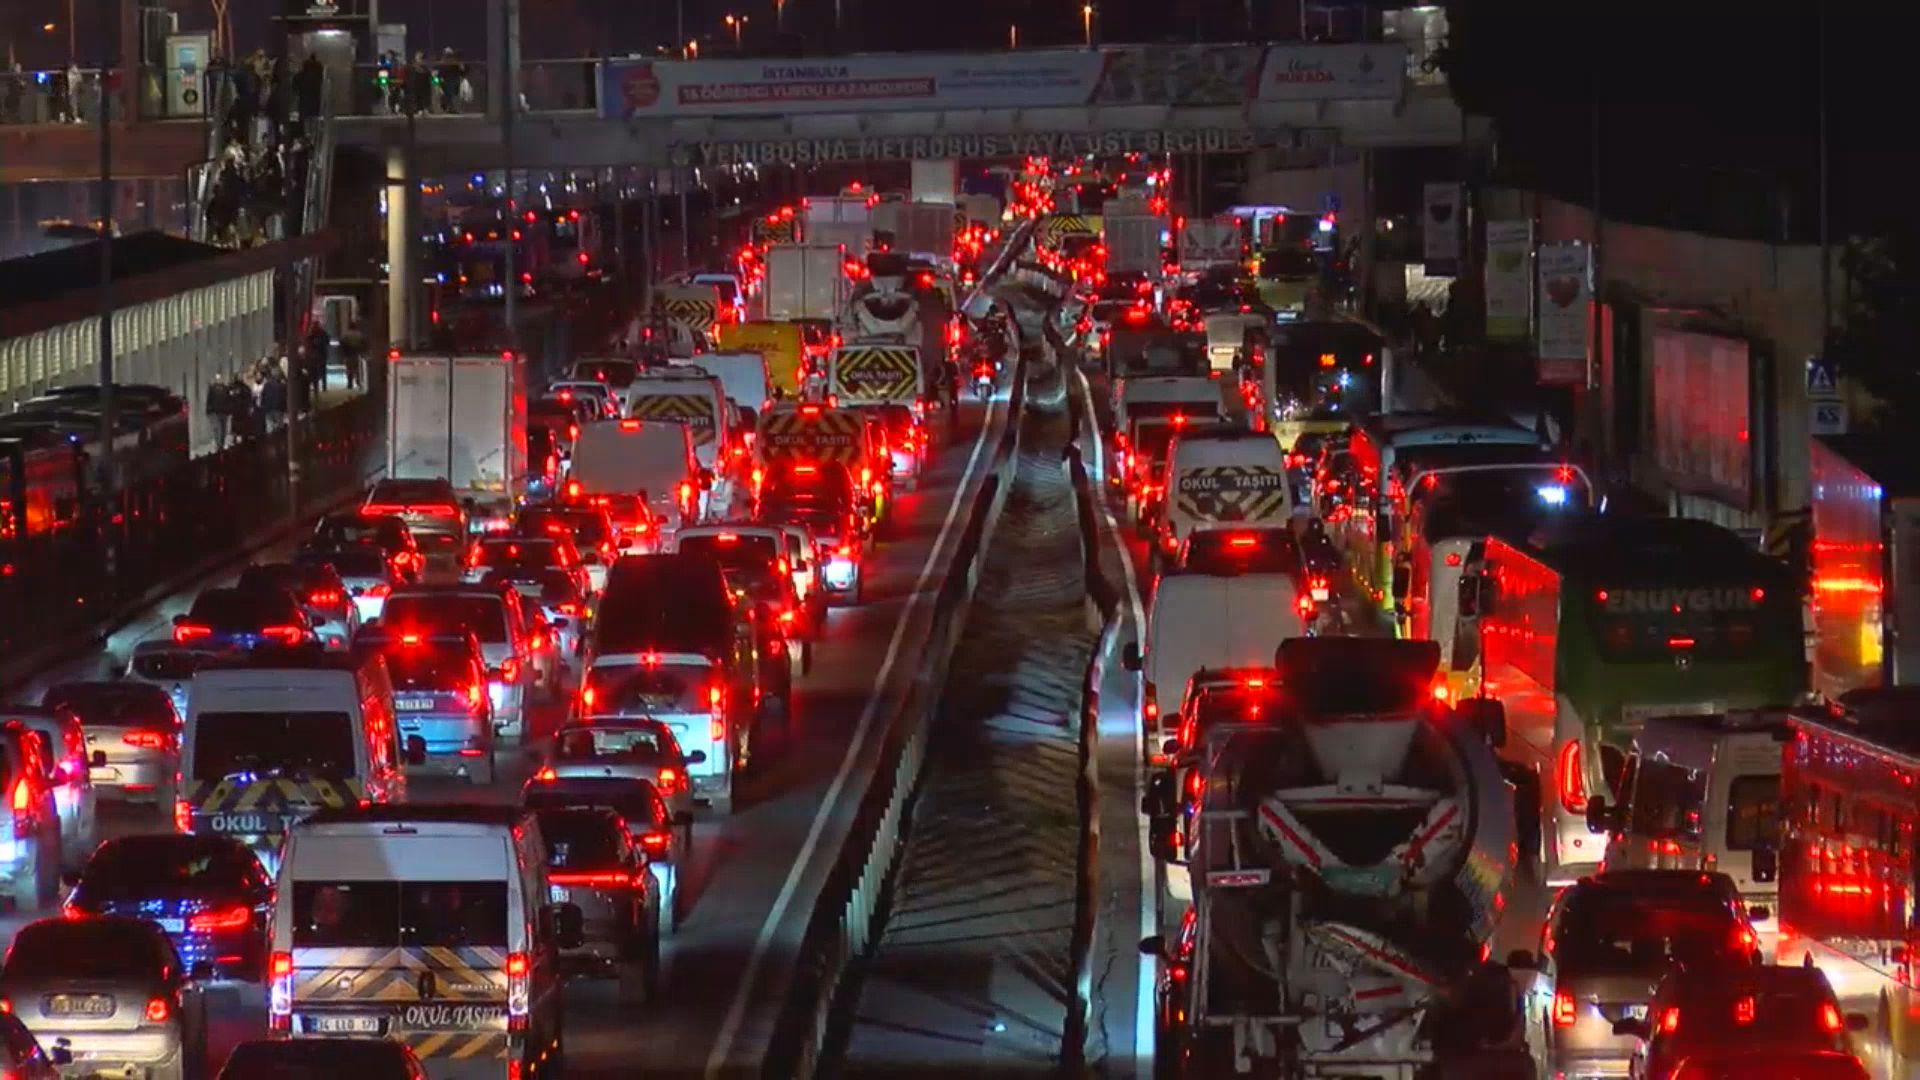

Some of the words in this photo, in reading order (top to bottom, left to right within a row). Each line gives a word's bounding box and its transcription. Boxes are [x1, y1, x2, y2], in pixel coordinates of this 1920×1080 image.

[1008, 133, 1074, 154] YAYA
[1182, 478, 1221, 490] OKUL
[406, 1005, 452, 1027] OKUL
